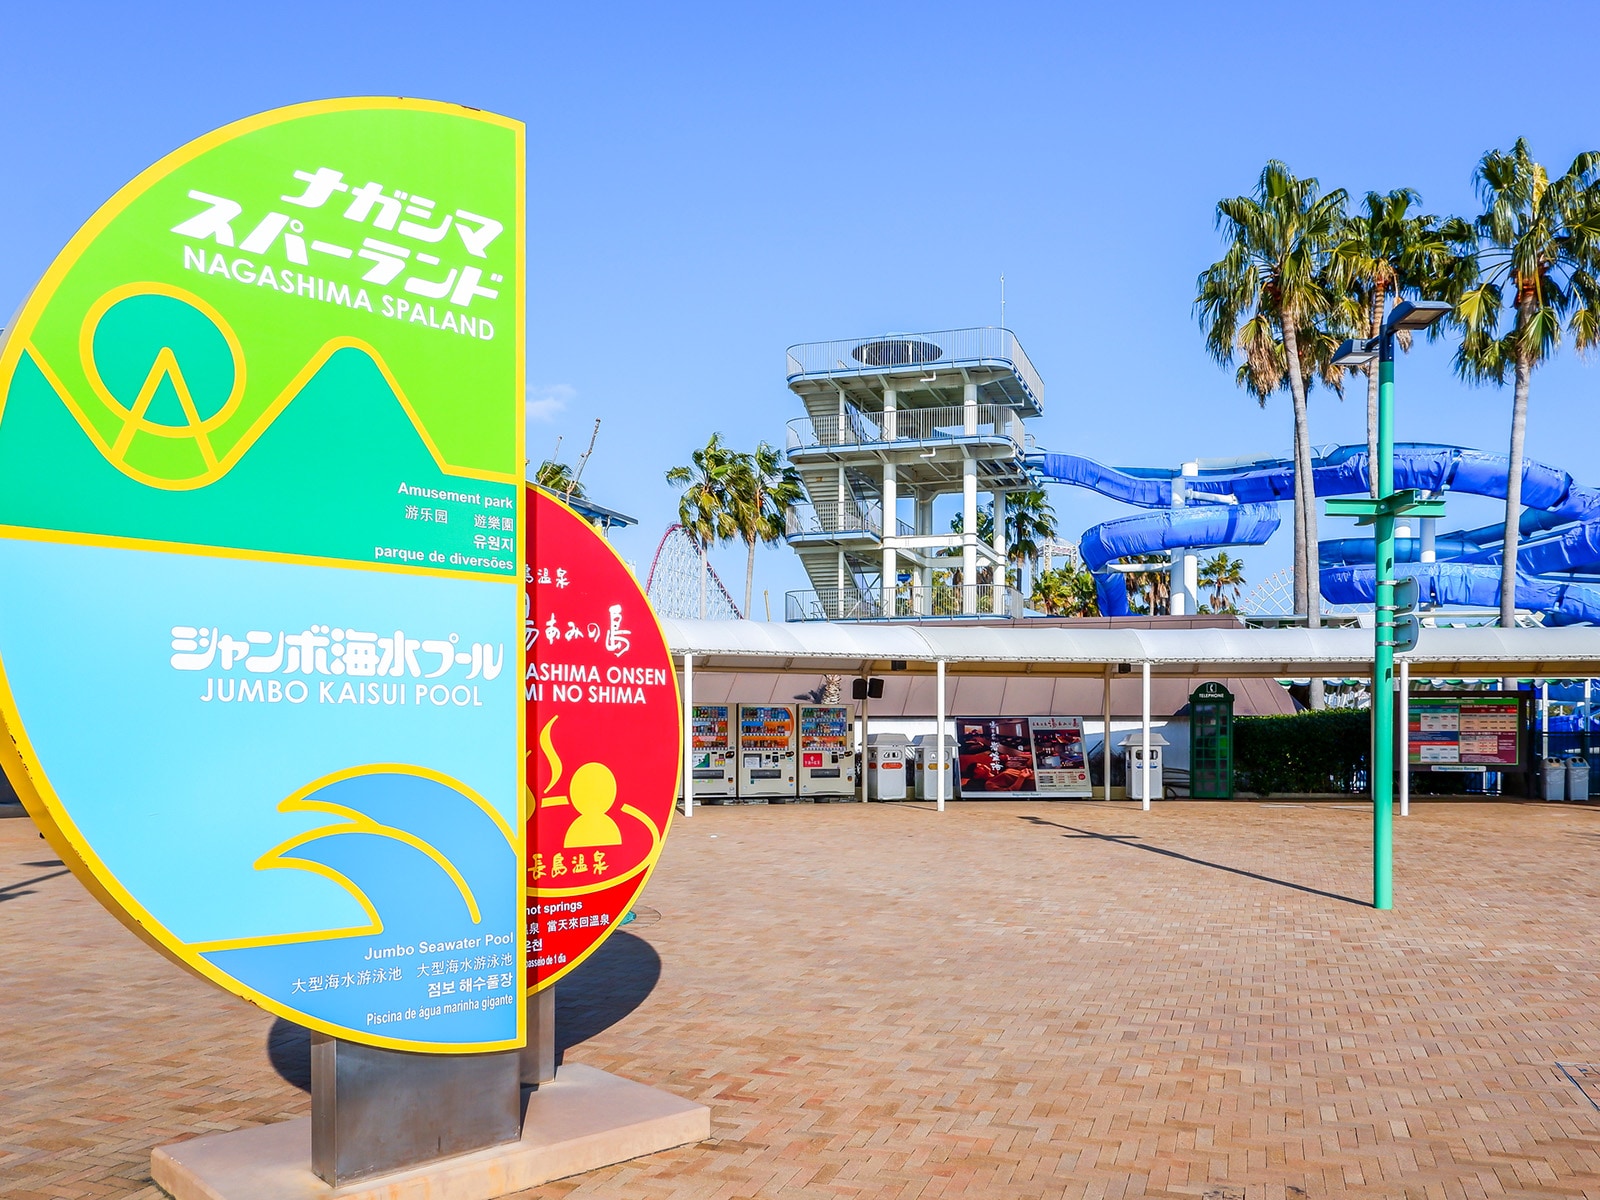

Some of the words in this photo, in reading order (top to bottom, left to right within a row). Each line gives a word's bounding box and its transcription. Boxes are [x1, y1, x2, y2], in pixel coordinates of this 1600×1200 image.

[280, 166, 504, 258] ナガシマ
[169, 189, 504, 307] スパーランド
[183, 245, 373, 313] NAGASHIMA
[381, 294, 495, 341] SPALAND
[398, 482, 481, 504] Amusement
[484, 496, 513, 509] park
[405, 505, 448, 524] 游乐园
[474, 514, 514, 532] 遊樂園
[473, 534, 514, 552] 유원지
[374, 546, 425, 562] parque
[428, 550, 446, 563] de
[449, 552, 514, 570] diversões
[170, 624, 504, 681] ジャンボ海水プール
[525, 663, 601, 683] ASHIMA
[606, 666, 666, 686] ONSEN
[199, 677, 309, 704] JUMBO
[319, 680, 406, 706] KAISUI
[415, 683, 483, 707] POOL
[525, 684, 543, 702] MI
[552, 684, 583, 703] NO
[588, 685, 647, 704] SHIMA
[527, 850, 610, 880] 長島温泉
[543, 900, 583, 915] springs
[526, 922, 540, 935] 泉
[364, 944, 415, 961] Jumbo
[418, 936, 482, 954] Seawater
[485, 932, 514, 947] Pool
[291, 966, 403, 994] 大型海水游泳池
[416, 952, 513, 978] 大型海水游泳池
[427, 981, 455, 999] 점보
[459, 971, 513, 993] 해수풀장
[366, 1008, 402, 1026] Piscina
[404, 1007, 416, 1019] de
[418, 1005, 441, 1021] água
[443, 999, 480, 1015] marinha
[482, 994, 514, 1012] gigante
